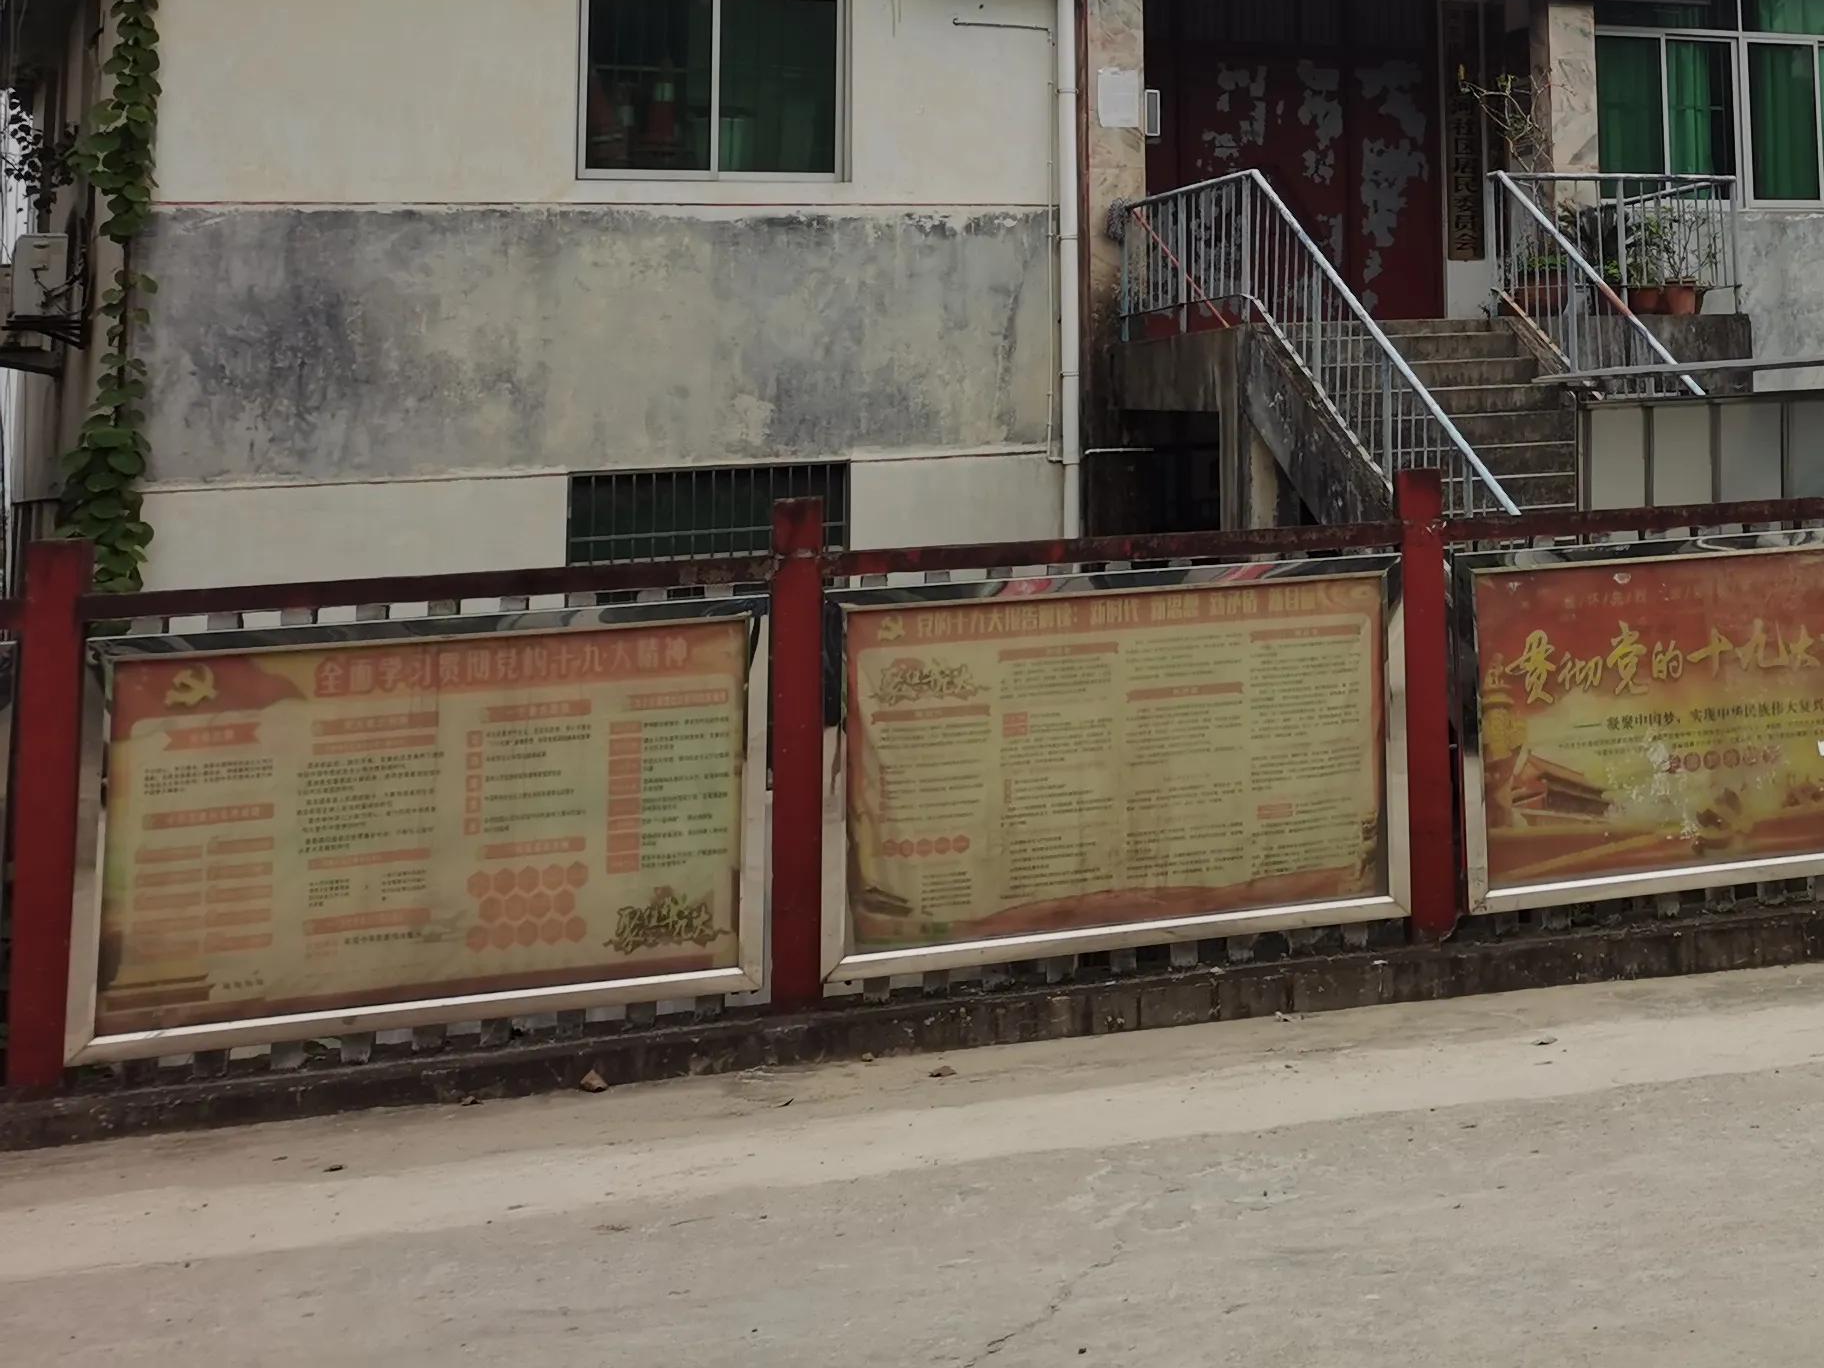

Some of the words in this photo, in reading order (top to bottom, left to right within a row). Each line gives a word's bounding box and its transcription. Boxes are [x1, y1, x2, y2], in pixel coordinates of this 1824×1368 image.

[320, 636, 688, 693] 全面学习贯彻党的十九大精神
